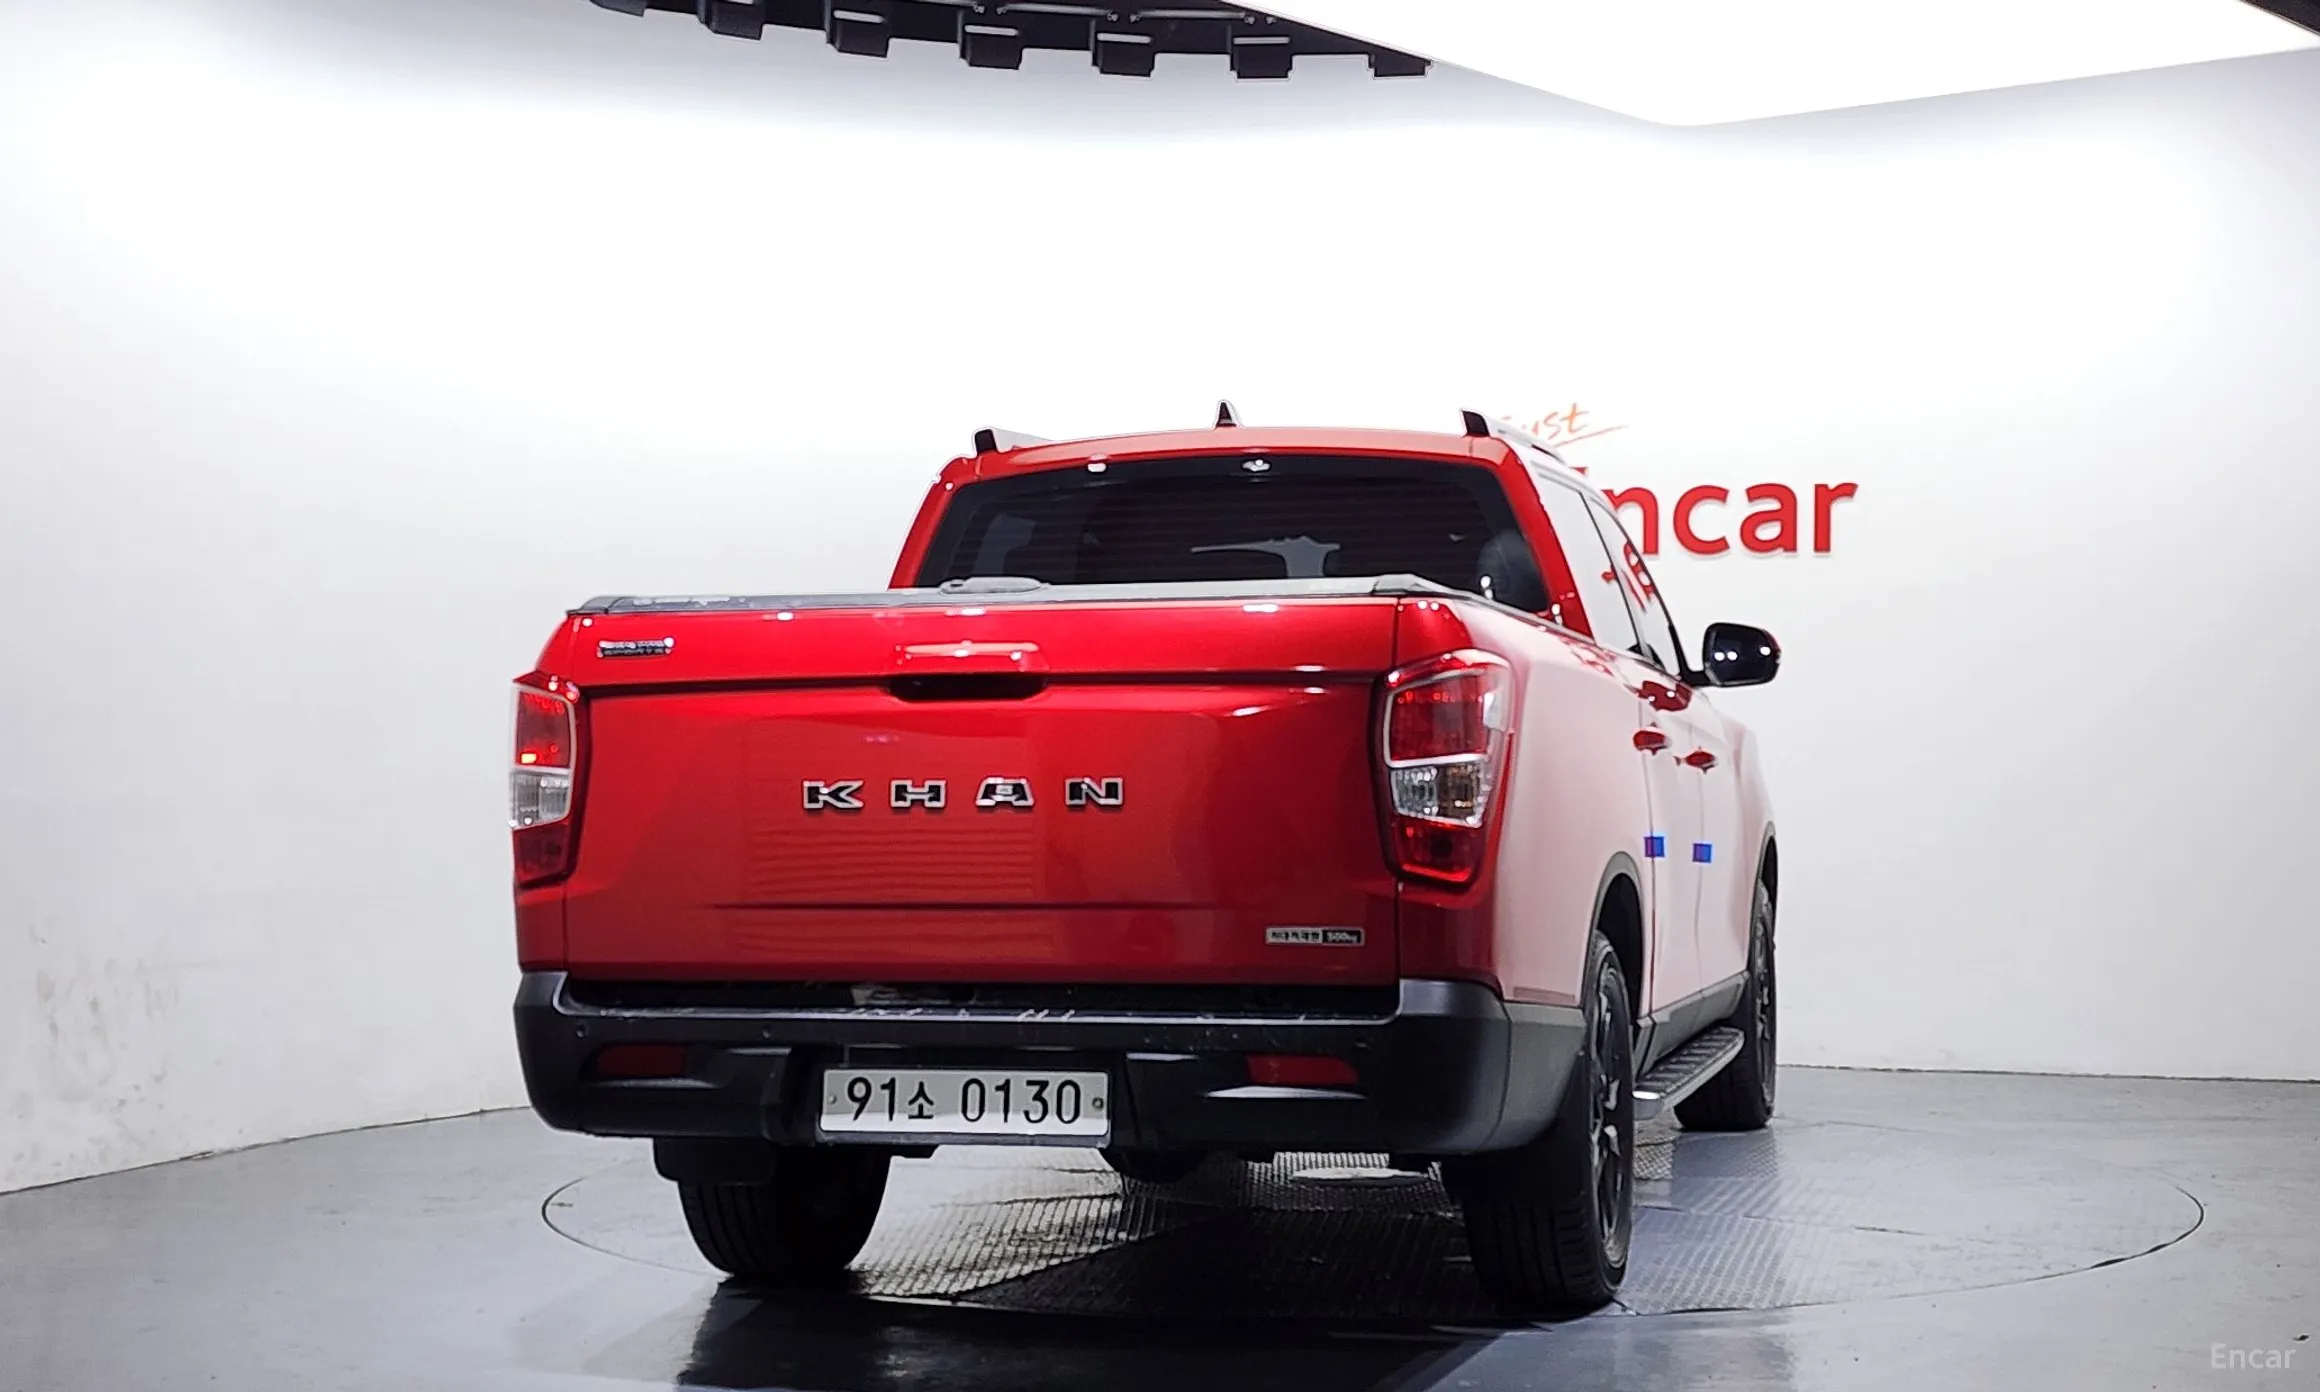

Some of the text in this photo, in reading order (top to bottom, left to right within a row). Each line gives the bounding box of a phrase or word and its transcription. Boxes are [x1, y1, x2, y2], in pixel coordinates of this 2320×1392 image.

[1570, 466, 1859, 556] ncar
[803, 776, 1124, 809] KHAN
[847, 1076, 1081, 1124] 91소 0130
